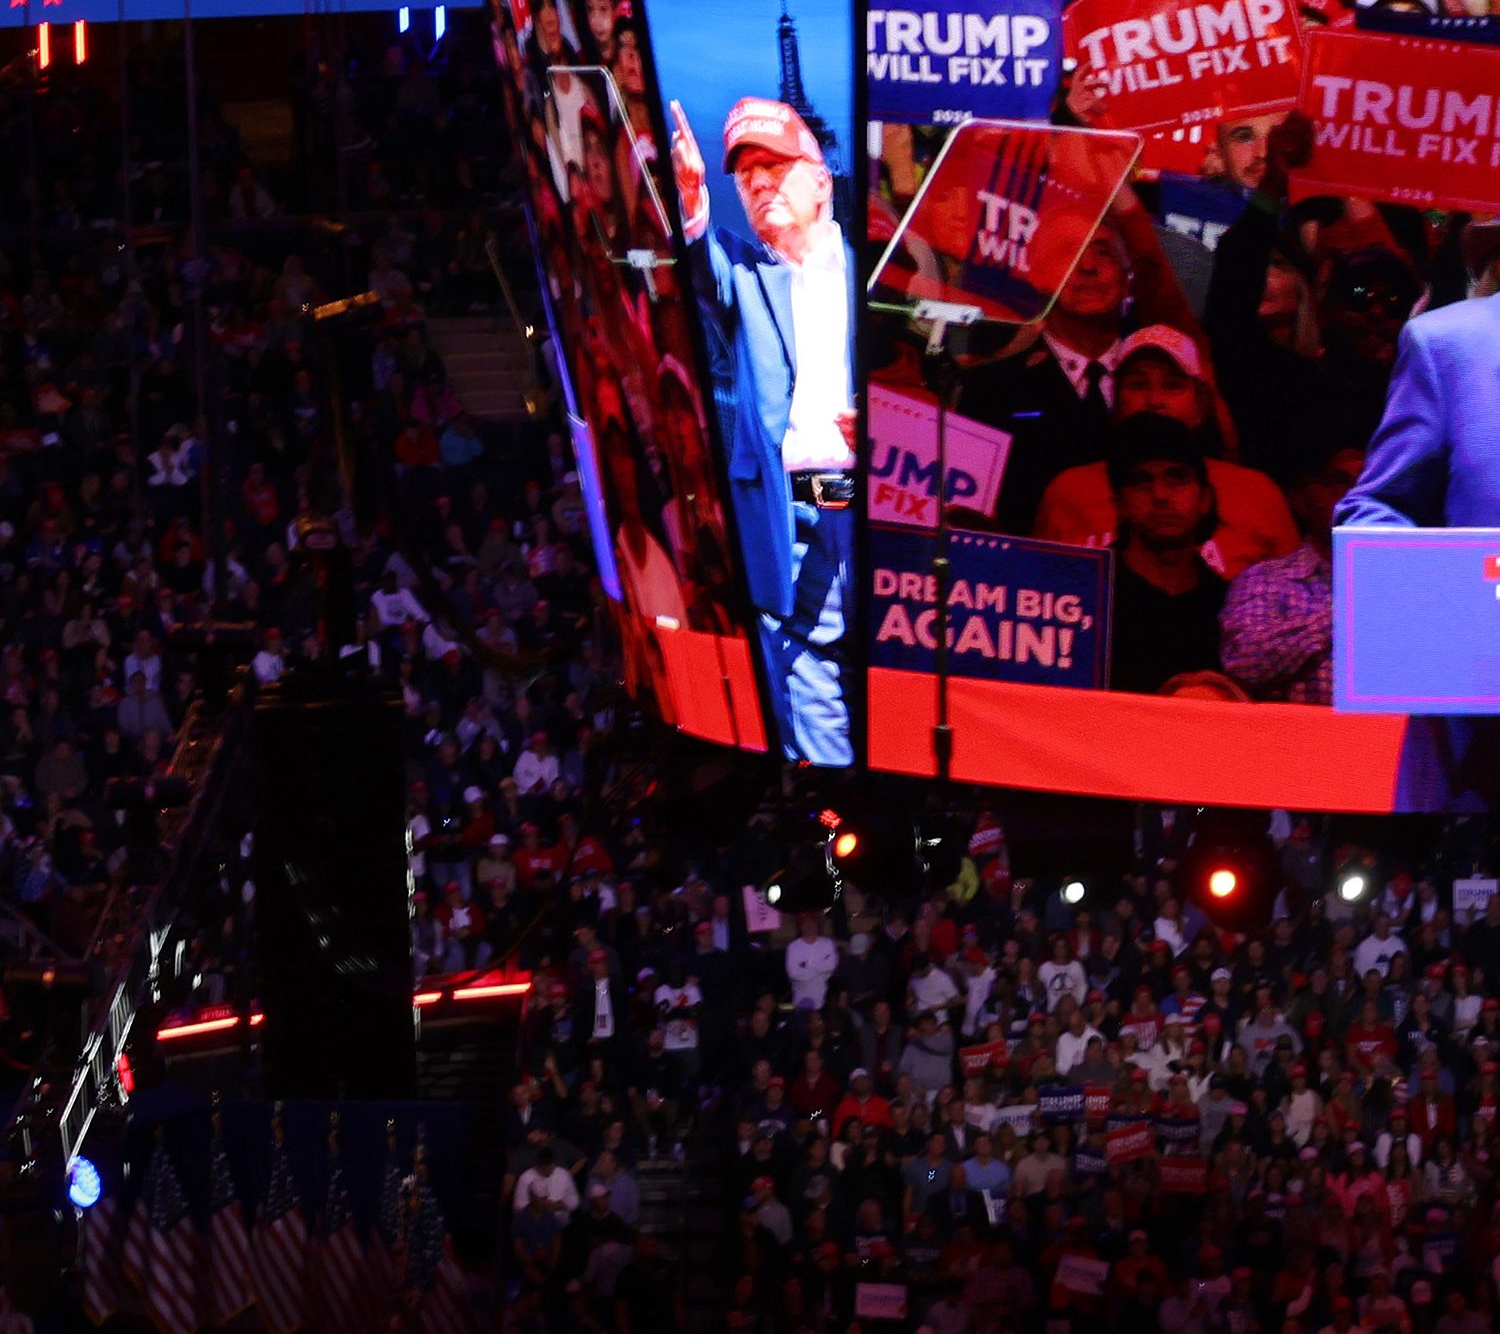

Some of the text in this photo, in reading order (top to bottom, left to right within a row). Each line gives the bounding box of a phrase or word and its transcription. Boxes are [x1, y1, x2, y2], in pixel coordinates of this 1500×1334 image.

[867, 10, 1050, 57] TRUMP
[948, 57, 1007, 85] FIX
[1014, 59, 1049, 87] IT
[1187, 43, 1251, 81] FIX
[1255, 35, 1292, 67] IT
[1314, 120, 1405, 156] WILL
[1417, 133, 1479, 165] FIX
[1391, 187, 1435, 202] 2024
[873, 483, 929, 521] FIX
[873, 568, 1093, 631] DREAM BIG,
[876, 604, 1075, 669] AGAIN!
